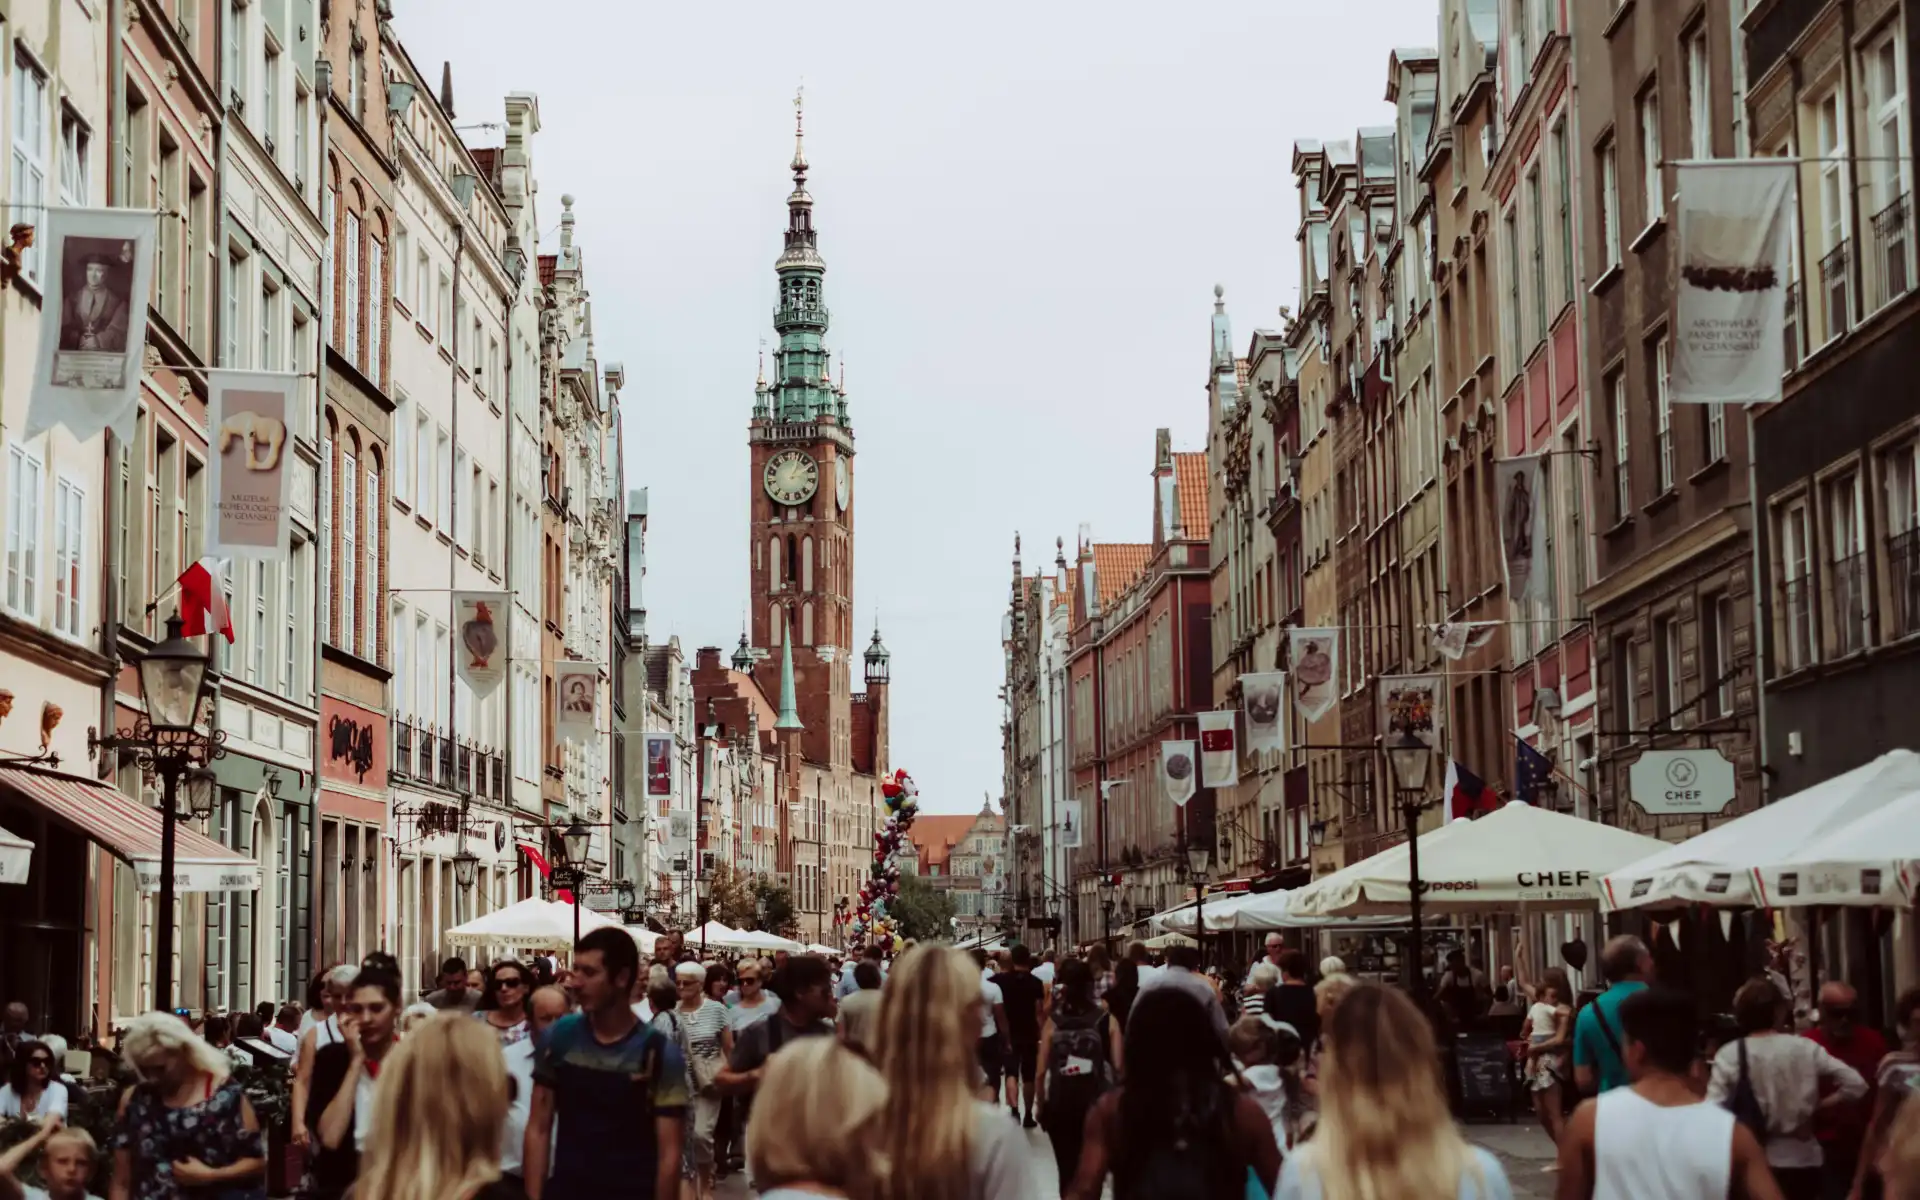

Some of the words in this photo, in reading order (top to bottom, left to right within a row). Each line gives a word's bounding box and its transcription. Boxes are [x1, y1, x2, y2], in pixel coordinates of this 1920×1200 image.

[231, 494, 270, 502] MUZEUM
[223, 512, 233, 520] W
[1664, 790, 1702, 800] CHEF
[1516, 870, 1591, 887] CHEF
[1432, 879, 1479, 893] pepsi
[1546, 890, 1554, 899] &
[504, 936, 549, 944] GRYCAN
